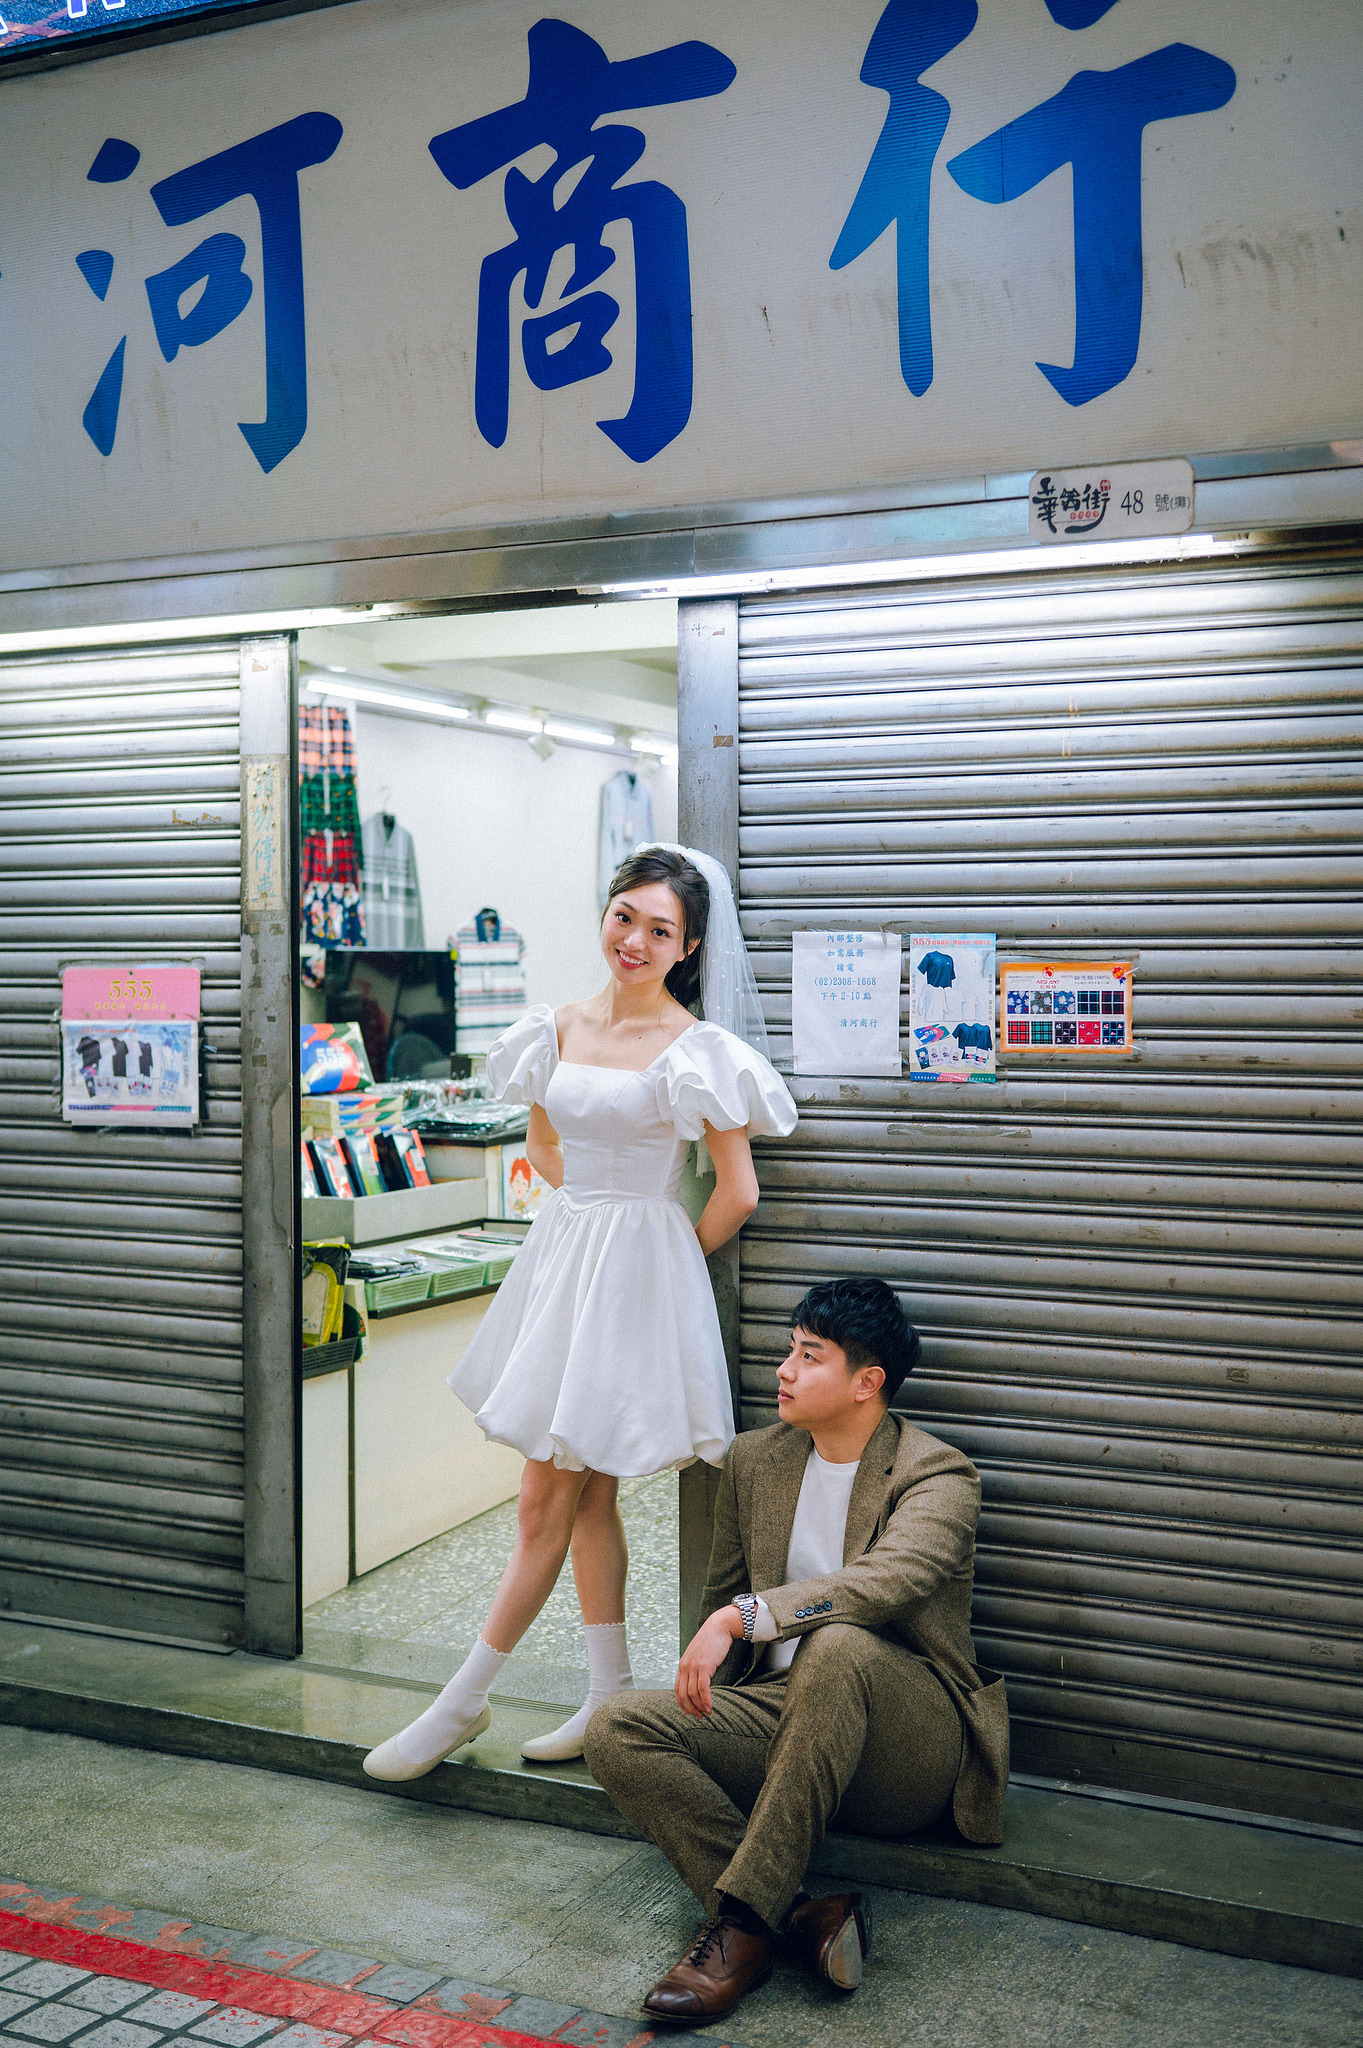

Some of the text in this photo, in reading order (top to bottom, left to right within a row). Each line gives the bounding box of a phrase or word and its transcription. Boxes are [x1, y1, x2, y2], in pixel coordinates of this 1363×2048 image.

[1121, 490, 1144, 515] 48
[912, 938, 931, 946] 555
[814, 977, 877, 986] (02)2308-1668
[109, 980, 152, 999] 555
[820, 992, 838, 1000] 下午
[840, 992, 860, 1000] 2-10
[840, 1018, 878, 1028] 清河商行
